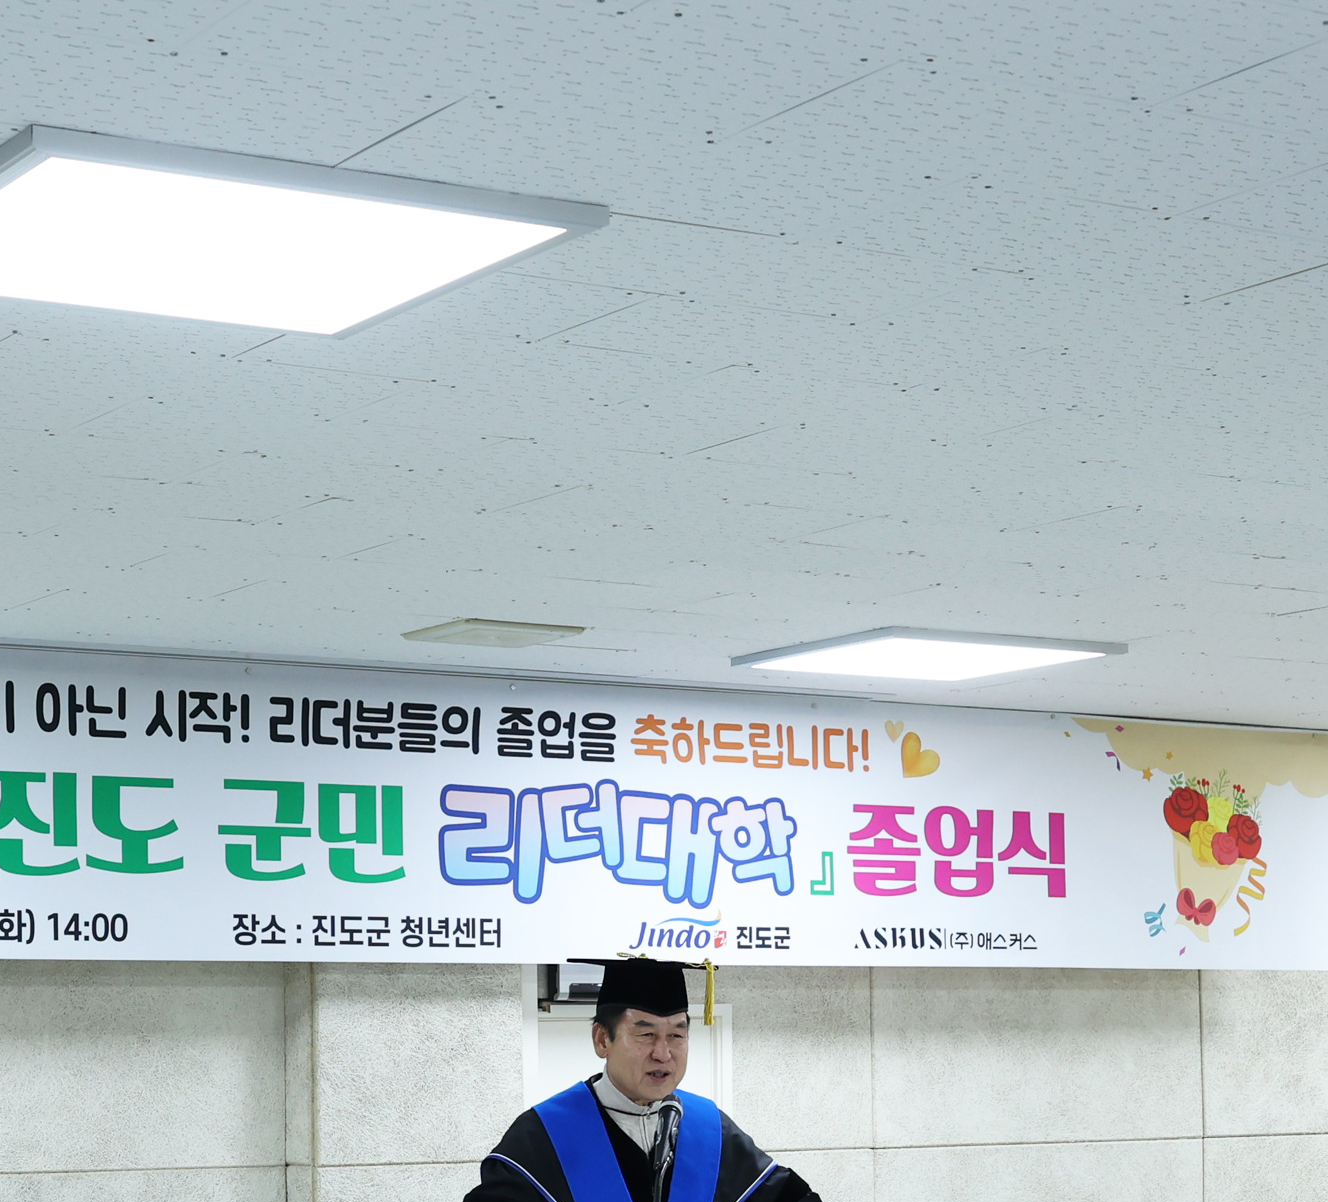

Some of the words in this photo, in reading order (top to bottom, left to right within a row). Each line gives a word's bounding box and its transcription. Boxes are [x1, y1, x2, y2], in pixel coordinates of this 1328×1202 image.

[35, 683, 128, 739] 아닌
[145, 690, 250, 744] 시작!
[268, 695, 482, 755] 리더분들의
[496, 702, 617, 763] 졸업을
[631, 712, 872, 774] 축하드립니다!
[218, 779, 406, 884] 군민
[846, 803, 1067, 899] 졸업식
[48, 913, 129, 943] 14:00
[232, 914, 287, 946] 장소
[297, 923, 302, 944] :
[312, 915, 391, 947] 진도군
[401, 916, 502, 949] 청년센터
[629, 922, 711, 949] Jindo
[737, 926, 791, 950] 진도군
